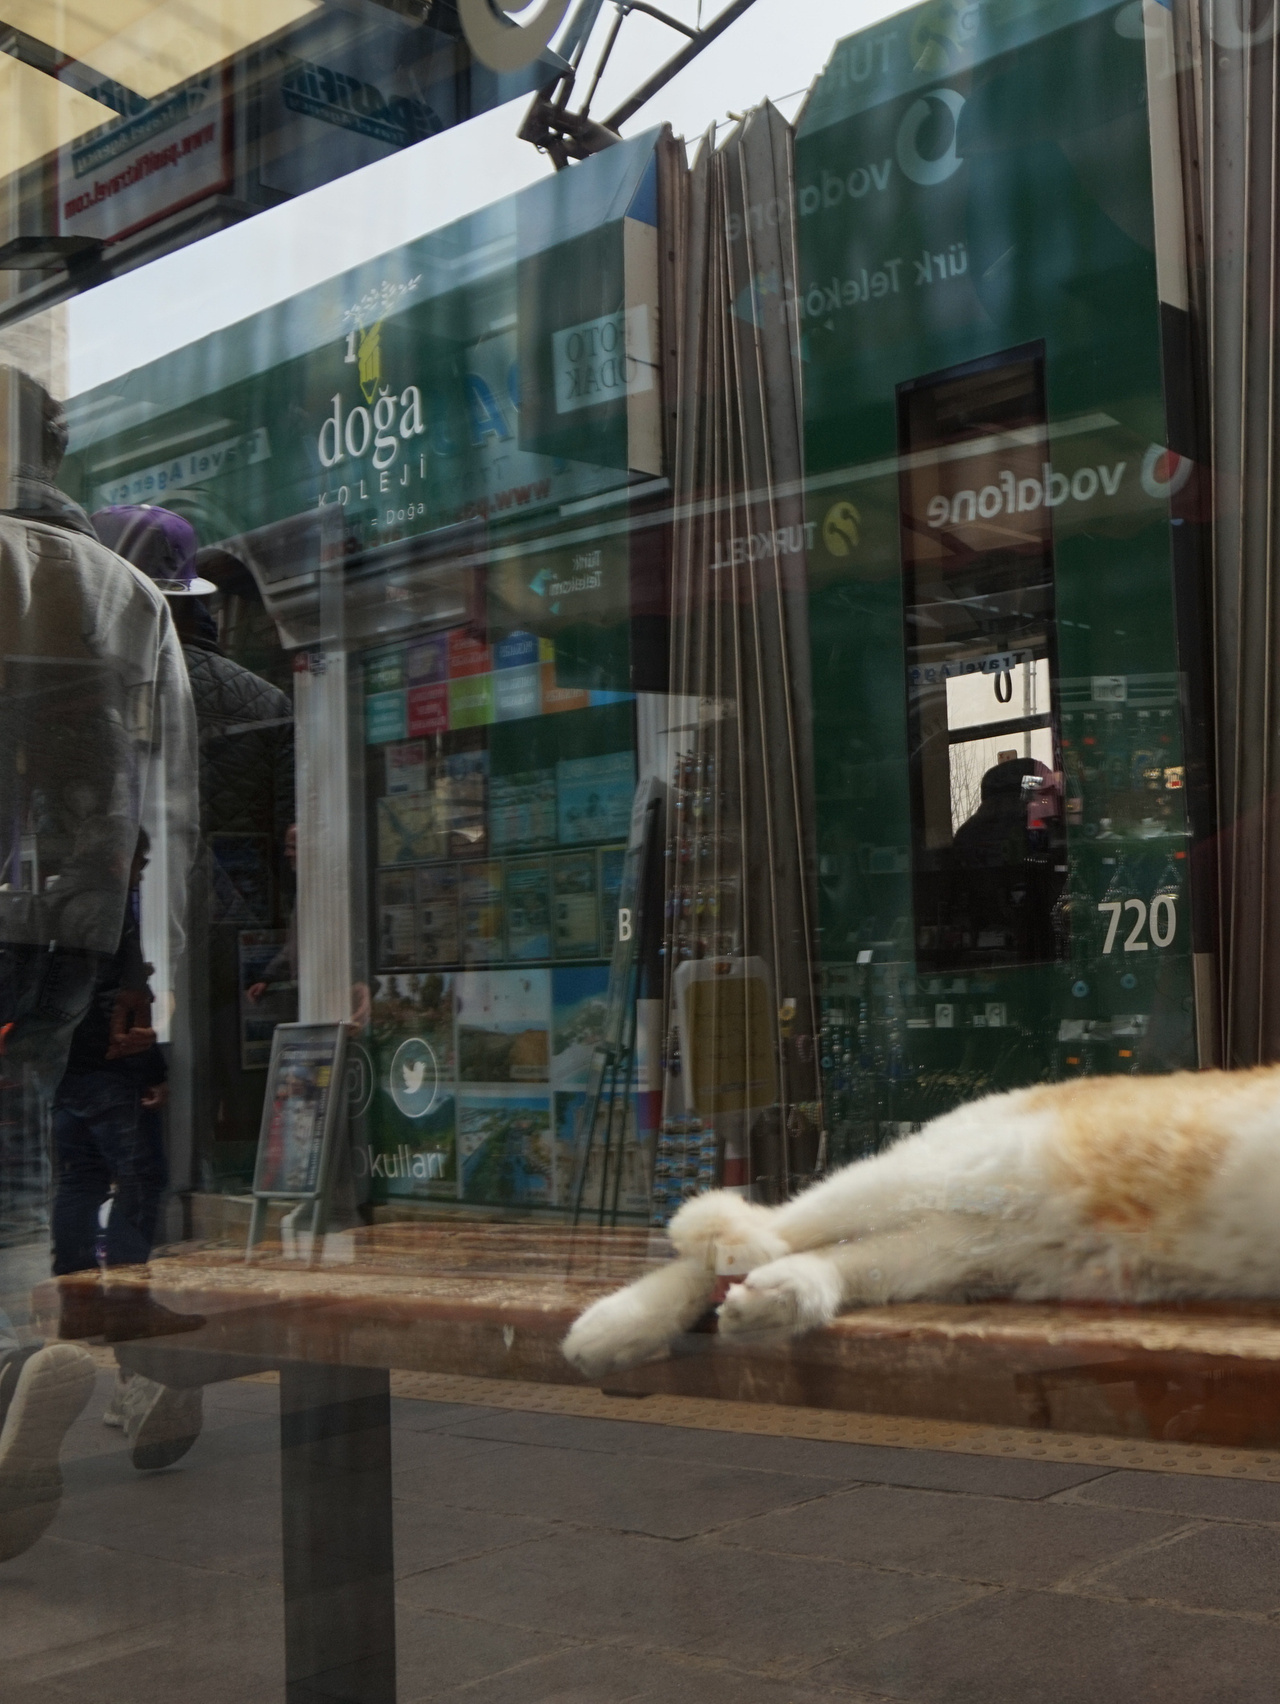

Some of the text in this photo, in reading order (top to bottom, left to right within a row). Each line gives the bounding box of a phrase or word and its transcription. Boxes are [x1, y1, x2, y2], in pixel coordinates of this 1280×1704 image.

[317, 383, 426, 471] doğa
[385, 500, 427, 526] Doğa
[617, 906, 633, 943] B
[1096, 894, 1177, 956] 720
